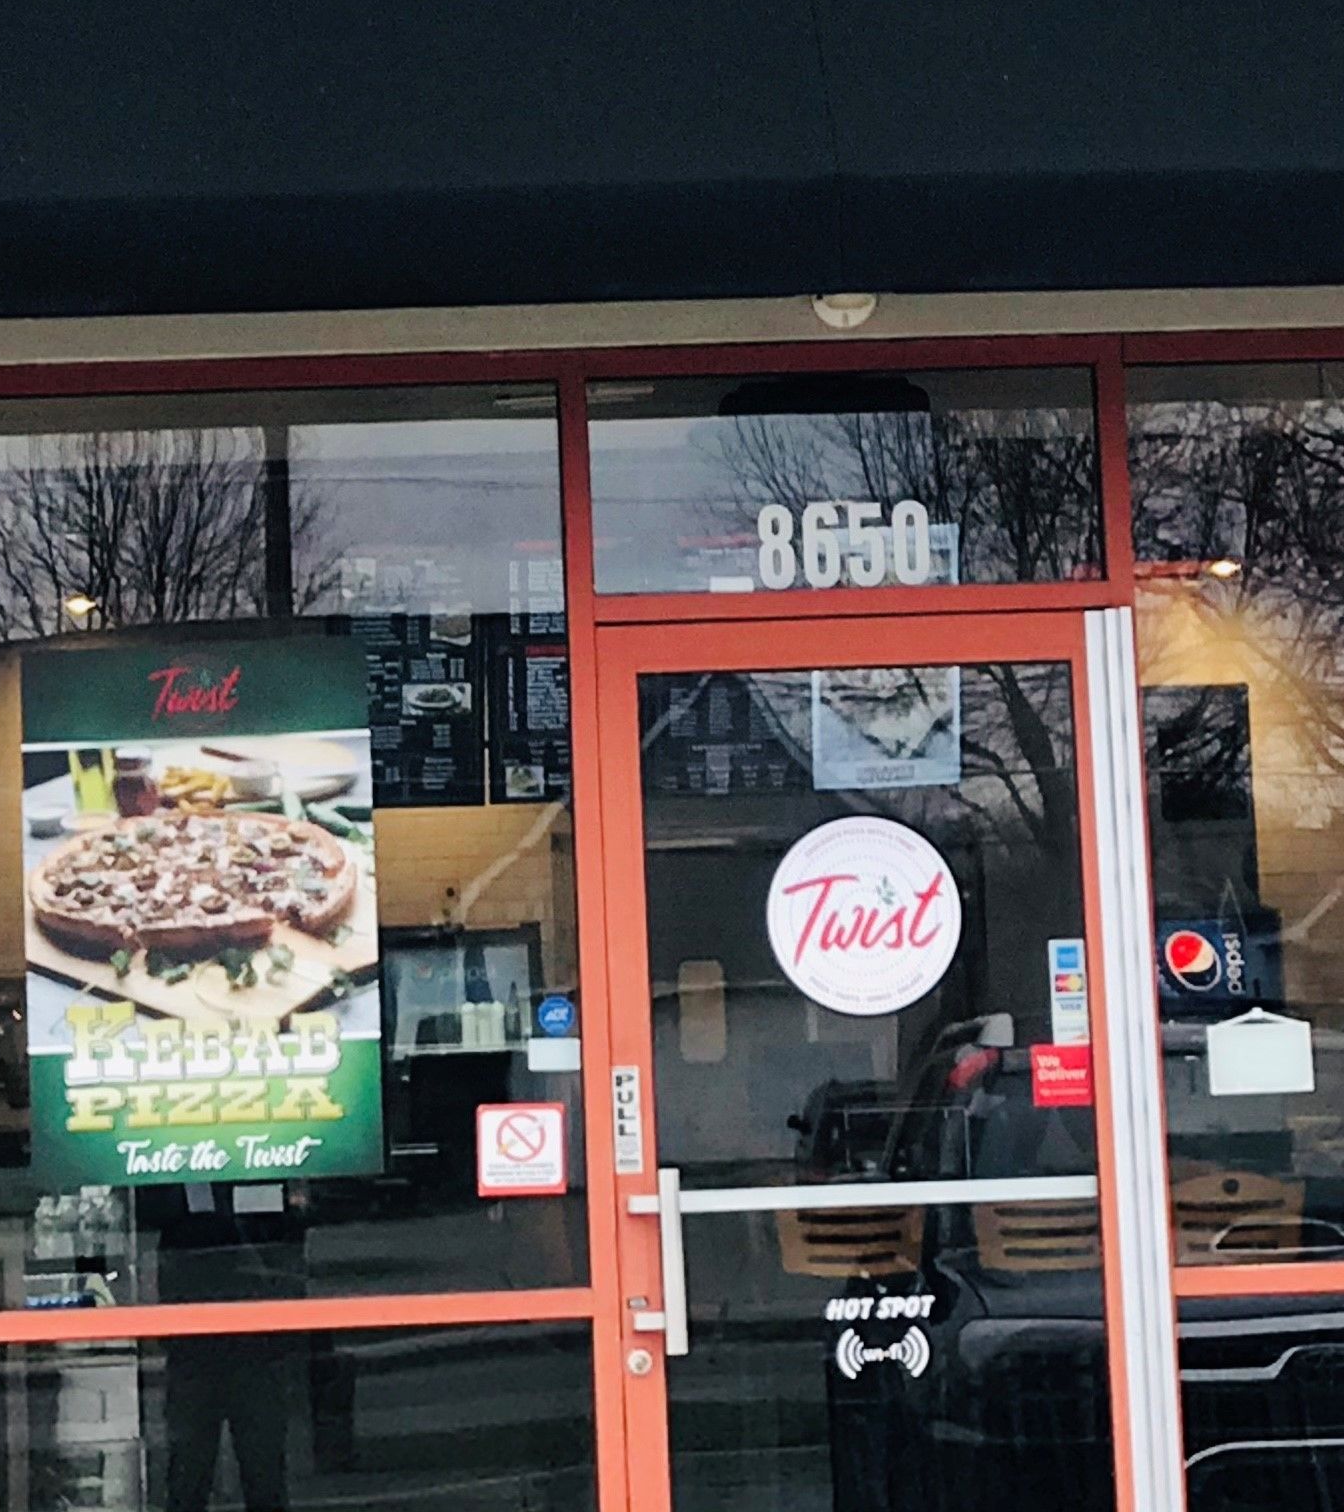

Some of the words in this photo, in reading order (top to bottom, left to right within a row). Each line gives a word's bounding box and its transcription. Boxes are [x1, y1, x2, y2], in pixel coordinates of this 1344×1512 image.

[757, 499, 931, 590] 8650
[147, 664, 242, 723] Twist
[782, 870, 945, 967] Twist
[1222, 932, 1246, 995] pepsi
[64, 1001, 342, 1087] KEBAB
[65, 1077, 345, 1131] PIZZA
[615, 1073, 637, 1137] PULL
[116, 1138, 187, 1176] Taste
[187, 1139, 232, 1172] the
[235, 1133, 324, 1170] Twist
[825, 1296, 875, 1322] HOT
[875, 1293, 937, 1321] SPOT
